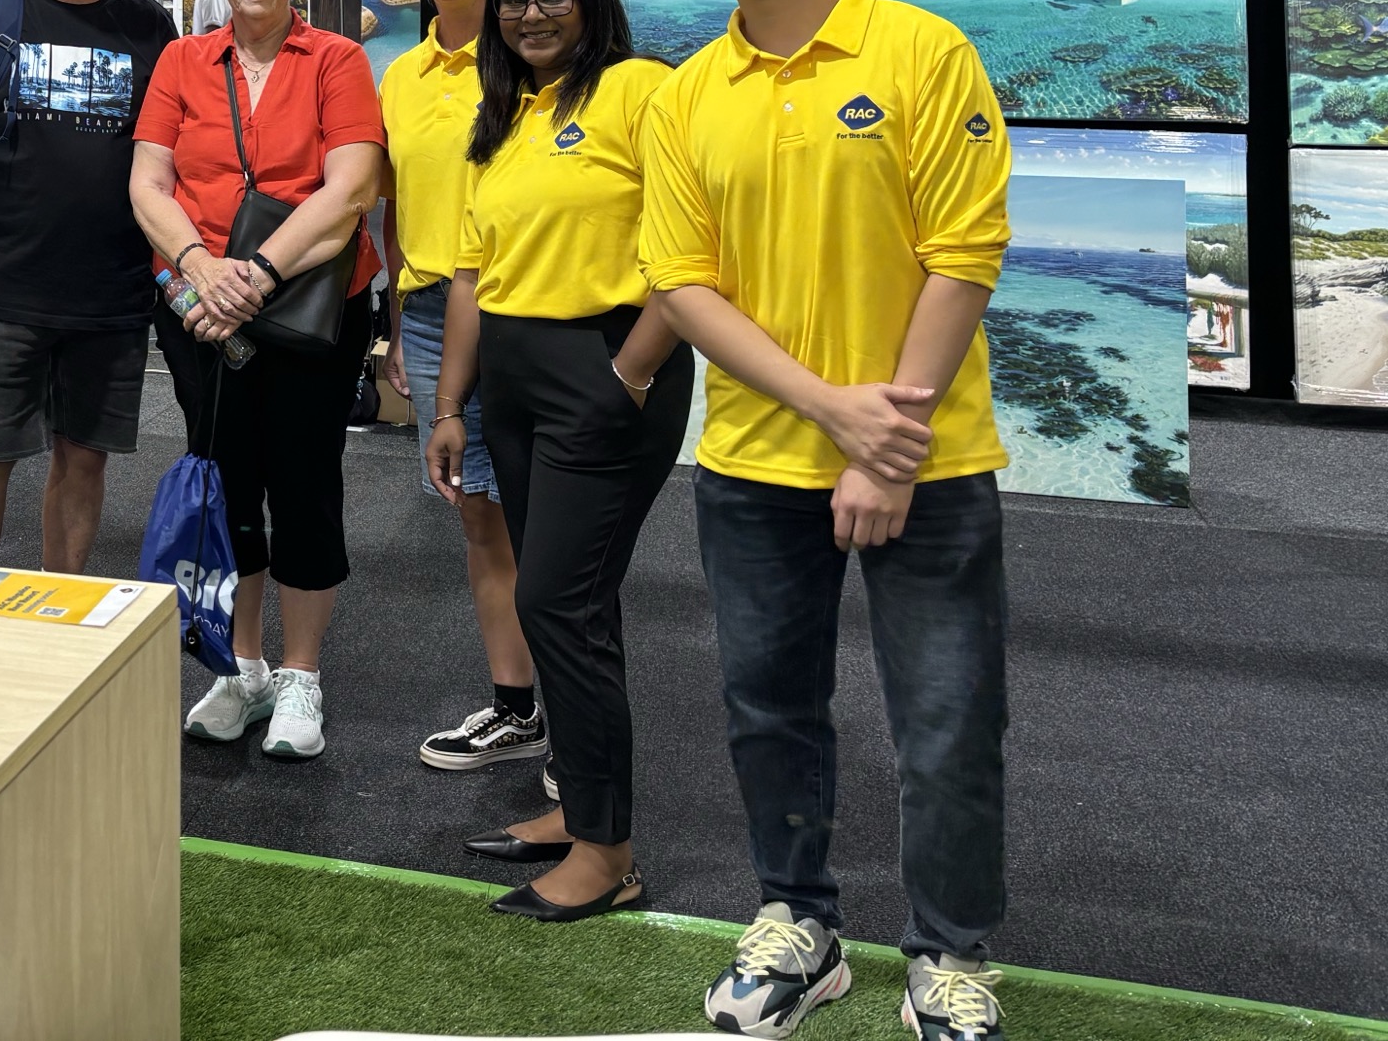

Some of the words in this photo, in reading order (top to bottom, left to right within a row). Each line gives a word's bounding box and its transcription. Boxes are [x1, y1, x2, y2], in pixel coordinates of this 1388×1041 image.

[16, 112, 62, 122] MIAMI
[844, 108, 877, 120] RAC
[75, 116, 123, 128] BEACH
[970, 121, 987, 131] RAC
[559, 132, 580, 142] RAC
